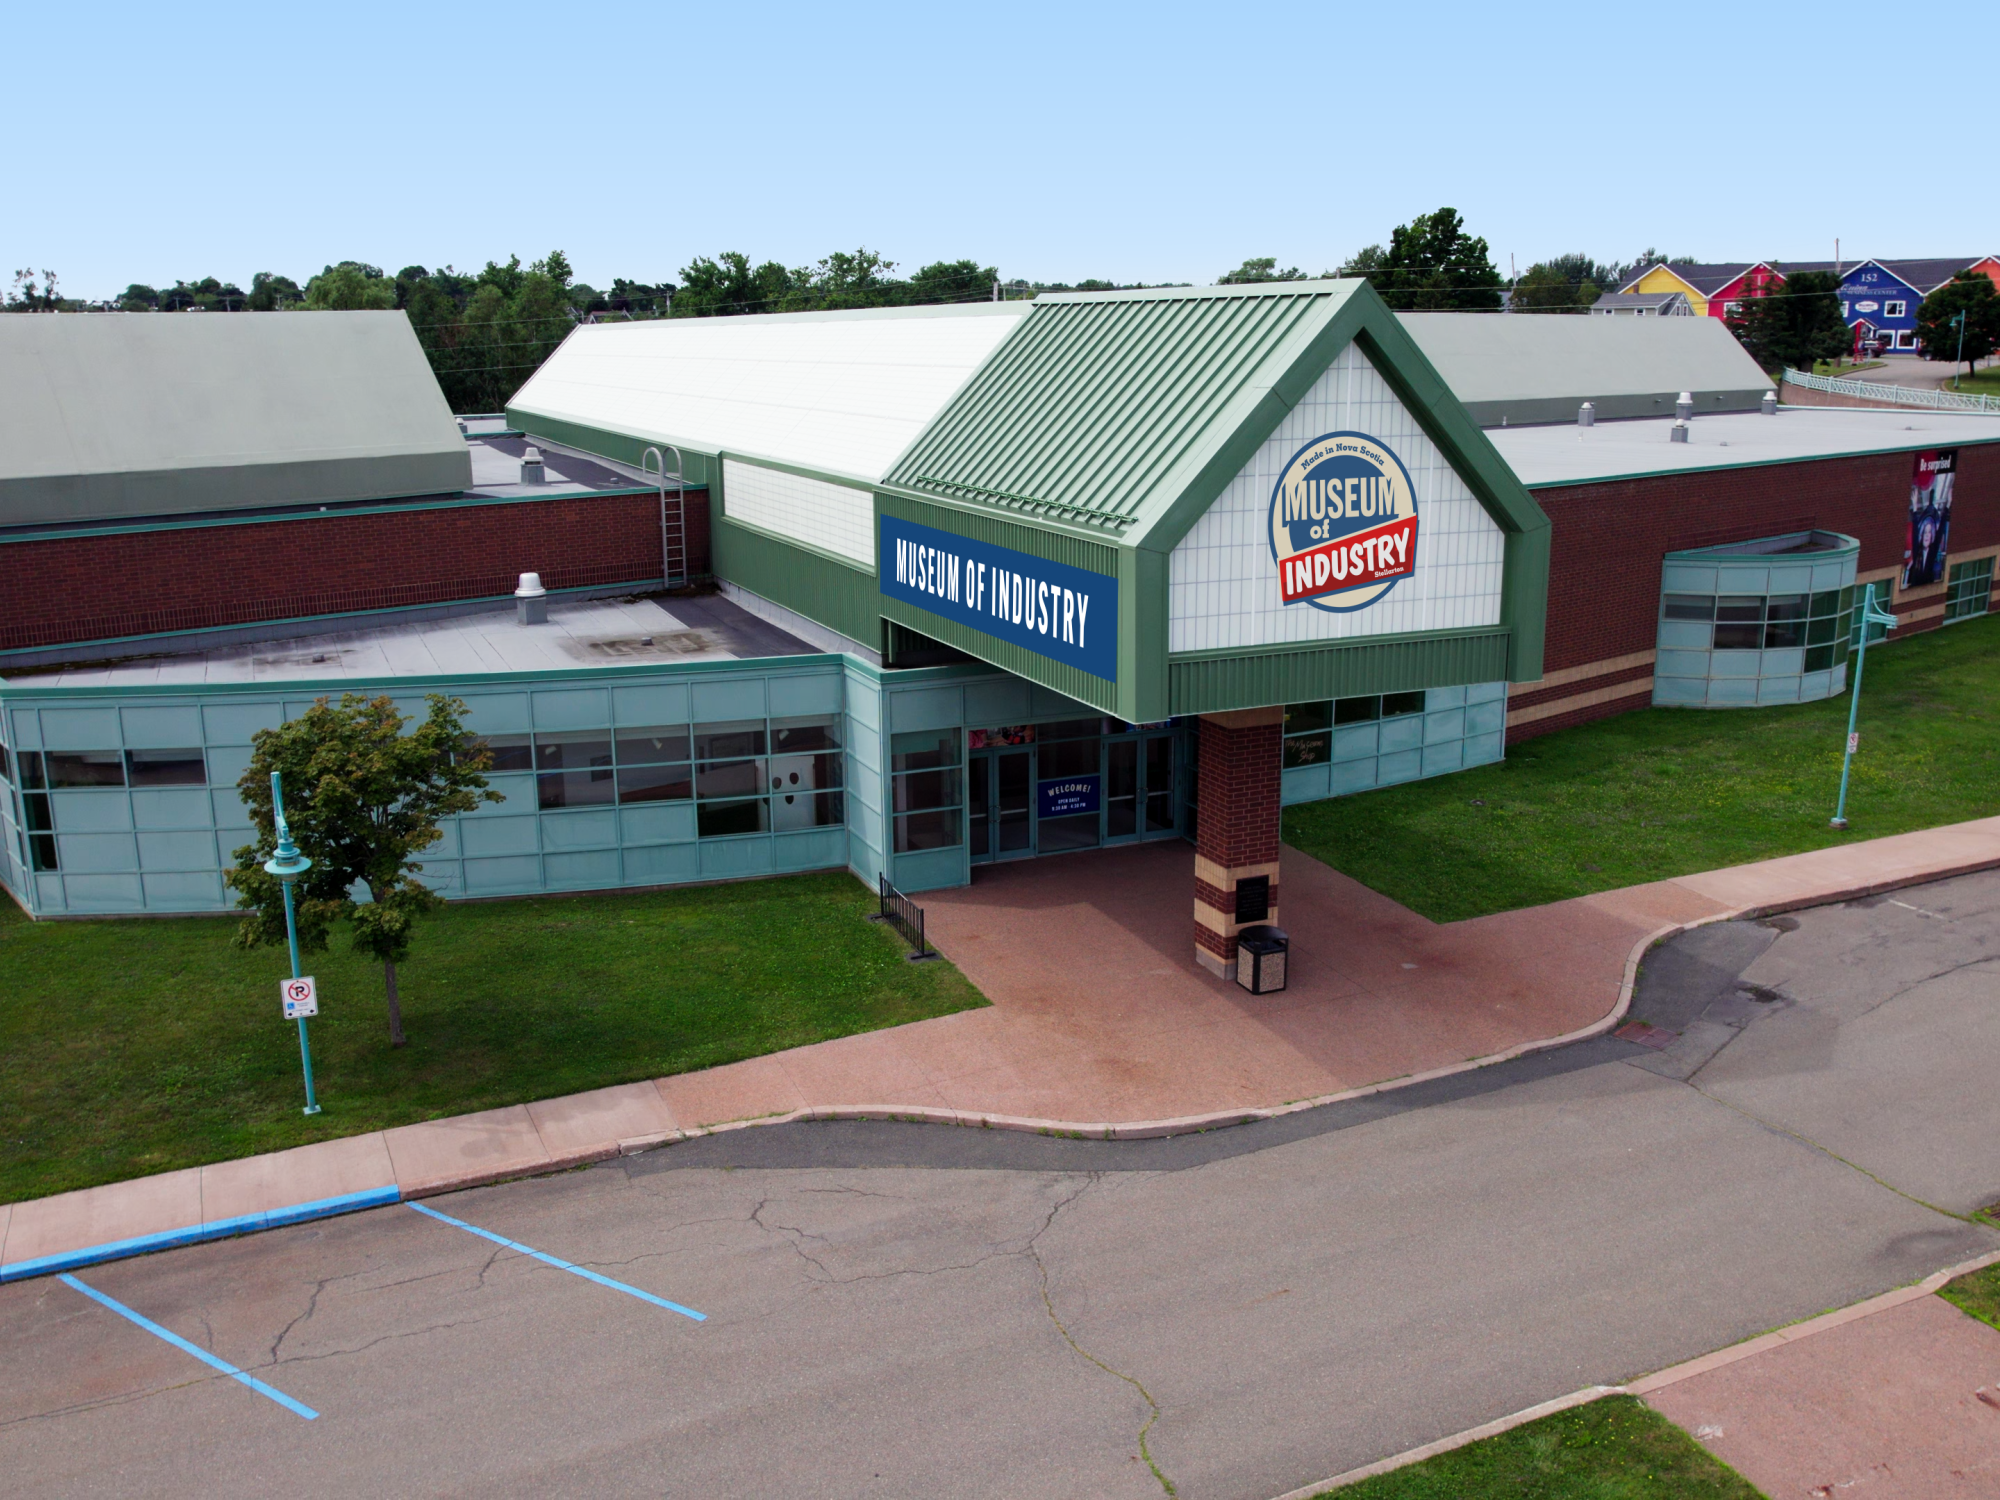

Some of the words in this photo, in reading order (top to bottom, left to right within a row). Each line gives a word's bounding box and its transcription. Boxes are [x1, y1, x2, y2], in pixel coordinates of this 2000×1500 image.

[1861, 273, 1878, 282] 152
[1300, 451, 1324, 470] Made
[1336, 443, 1358, 452] Nova
[1360, 446, 1384, 466] Scotia
[1920, 458, 1927, 471] Be
[1927, 454, 1952, 474] surprised
[1284, 476, 1400, 521] MUSEUM
[1309, 518, 1330, 539] of
[1285, 527, 1410, 595] INDUSTRY
[1374, 566, 1404, 578] Stellarton
[896, 538, 959, 603] MUSEUM
[965, 559, 986, 611] OF
[991, 566, 1089, 648] INDUSTRY
[1047, 783, 1091, 797] WELCOME!
